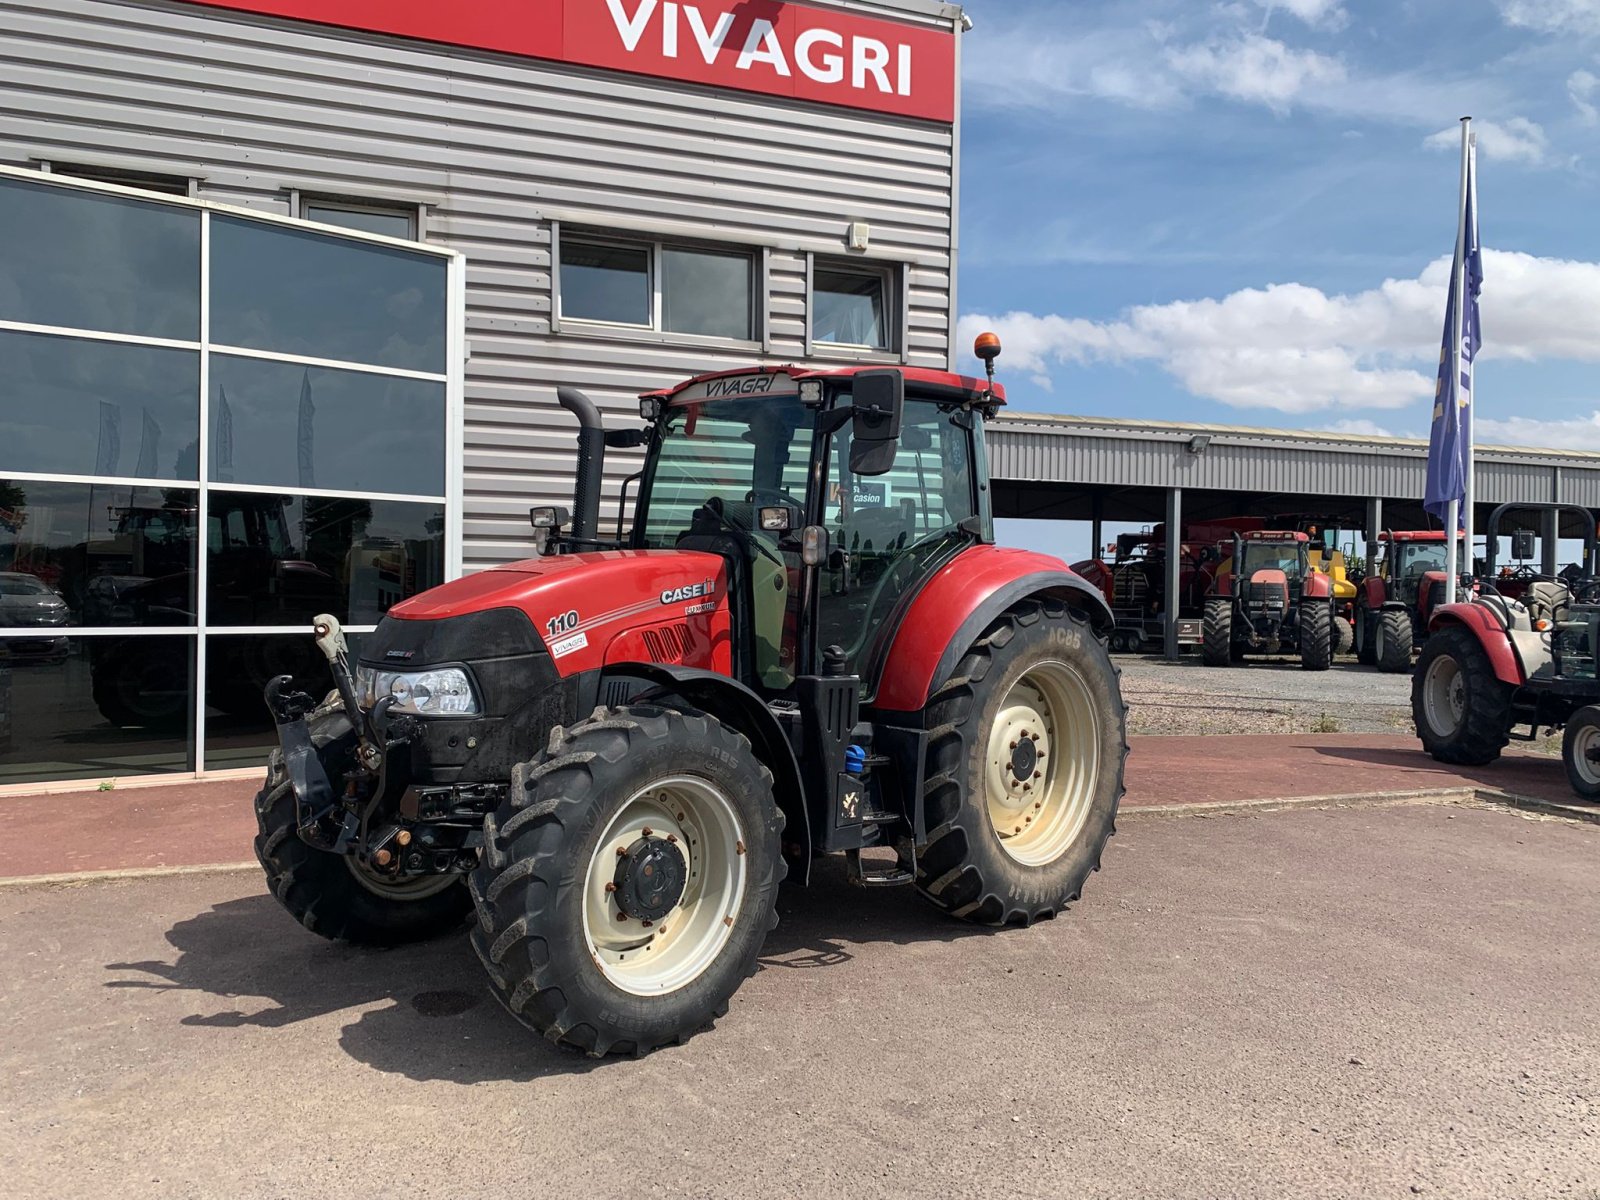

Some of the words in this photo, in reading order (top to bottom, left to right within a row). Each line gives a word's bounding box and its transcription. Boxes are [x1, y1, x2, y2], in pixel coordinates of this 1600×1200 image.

[606, 0, 911, 97] VIVAGRI
[706, 374, 776, 397] VIVAGRI
[853, 494, 880, 503] casion
[661, 583, 703, 604] CASE
[546, 610, 579, 636] 110
